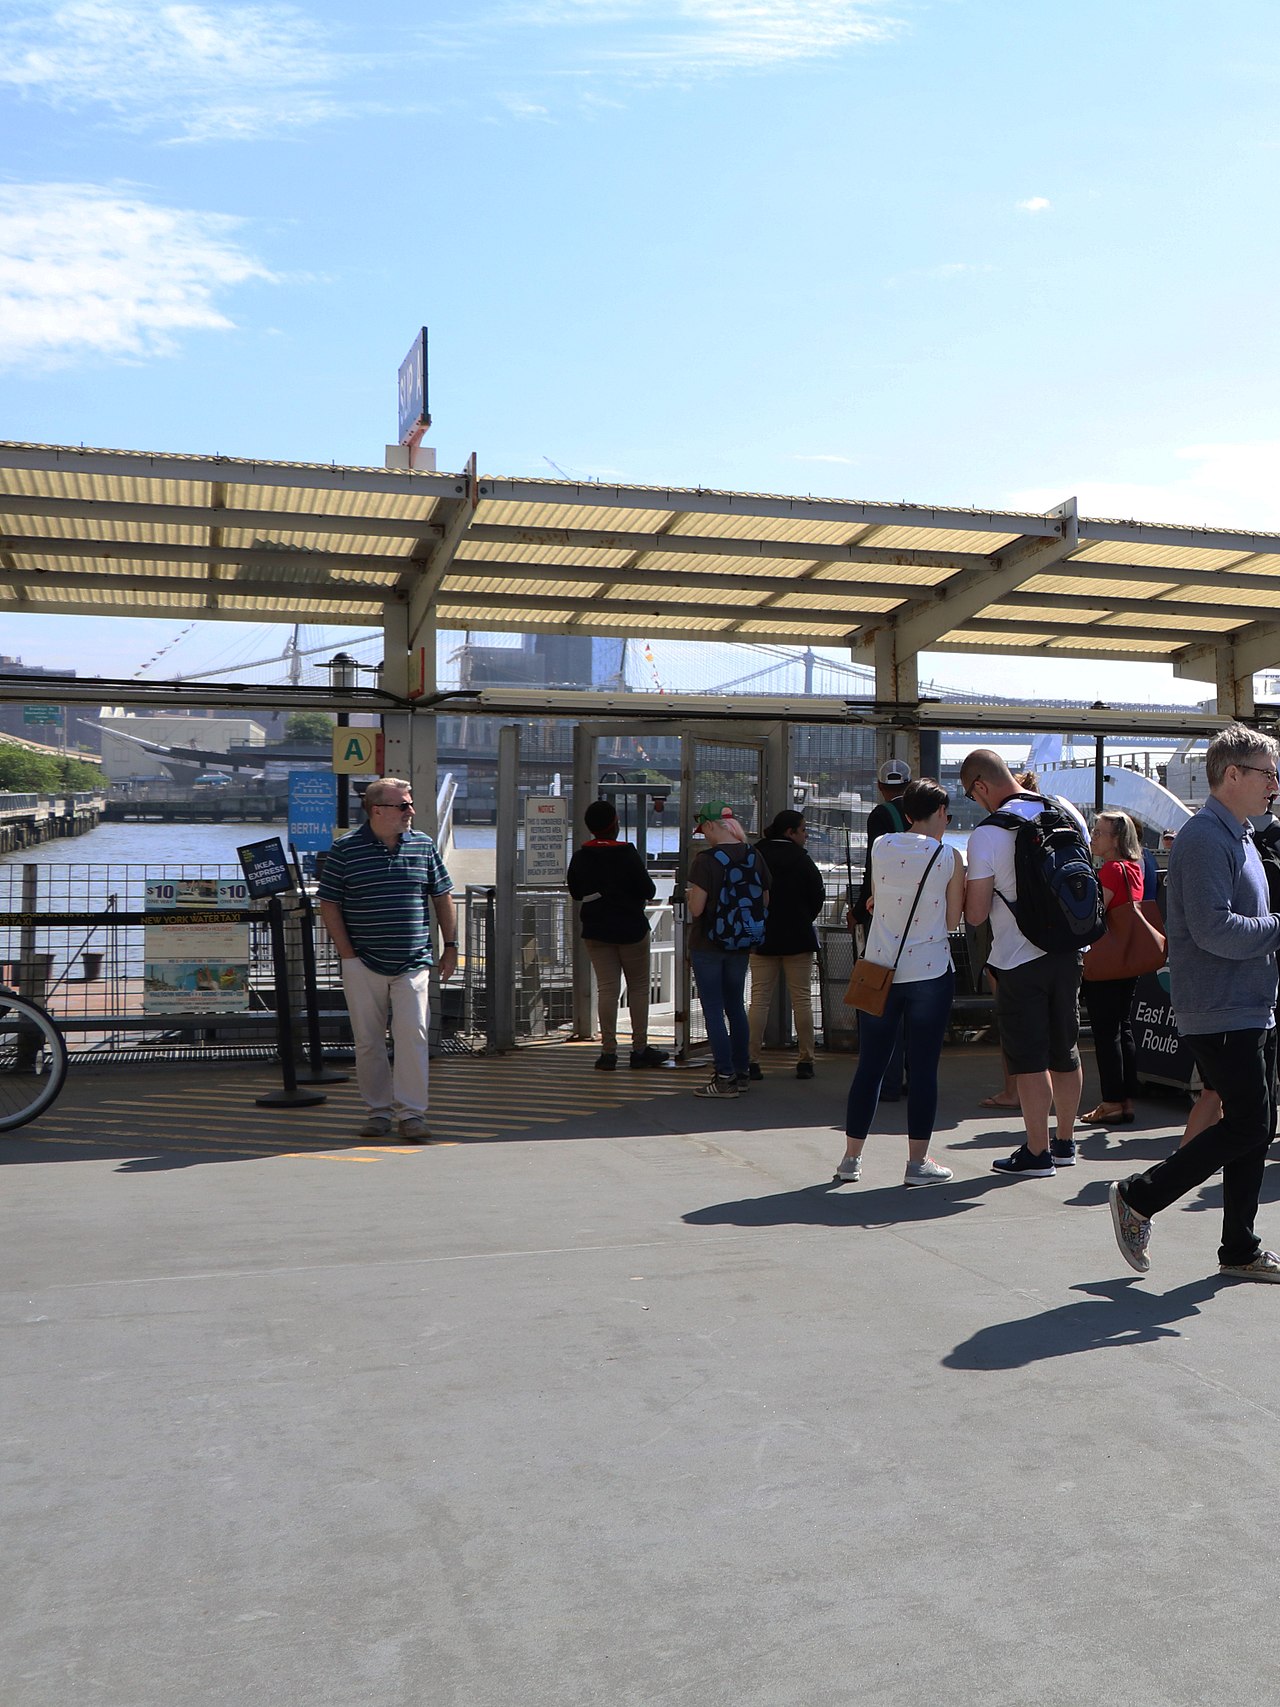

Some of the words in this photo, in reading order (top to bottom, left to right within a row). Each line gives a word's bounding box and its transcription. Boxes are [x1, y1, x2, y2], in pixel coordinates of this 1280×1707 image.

[400, 363, 413, 425] SLIP
[416, 349, 422, 401] A
[344, 738, 364, 761] A
[537, 805, 556, 813] NOTICE
[290, 822, 320, 834] BERTH
[248, 865, 286, 880] EXPRESS
[254, 860, 275, 870] IKEA
[255, 874, 282, 886] FERRY
[146, 884, 174, 899] $10
[219, 884, 246, 899] $10
[11, 917, 32, 925] TAXI
[141, 916, 160, 925] NEW
[163, 916, 189, 924] YORK
[190, 914, 220, 923] WATER
[220, 913, 240, 922] TAXI
[1135, 1001, 1165, 1025] East
[1141, 1028, 1179, 1055] Route
